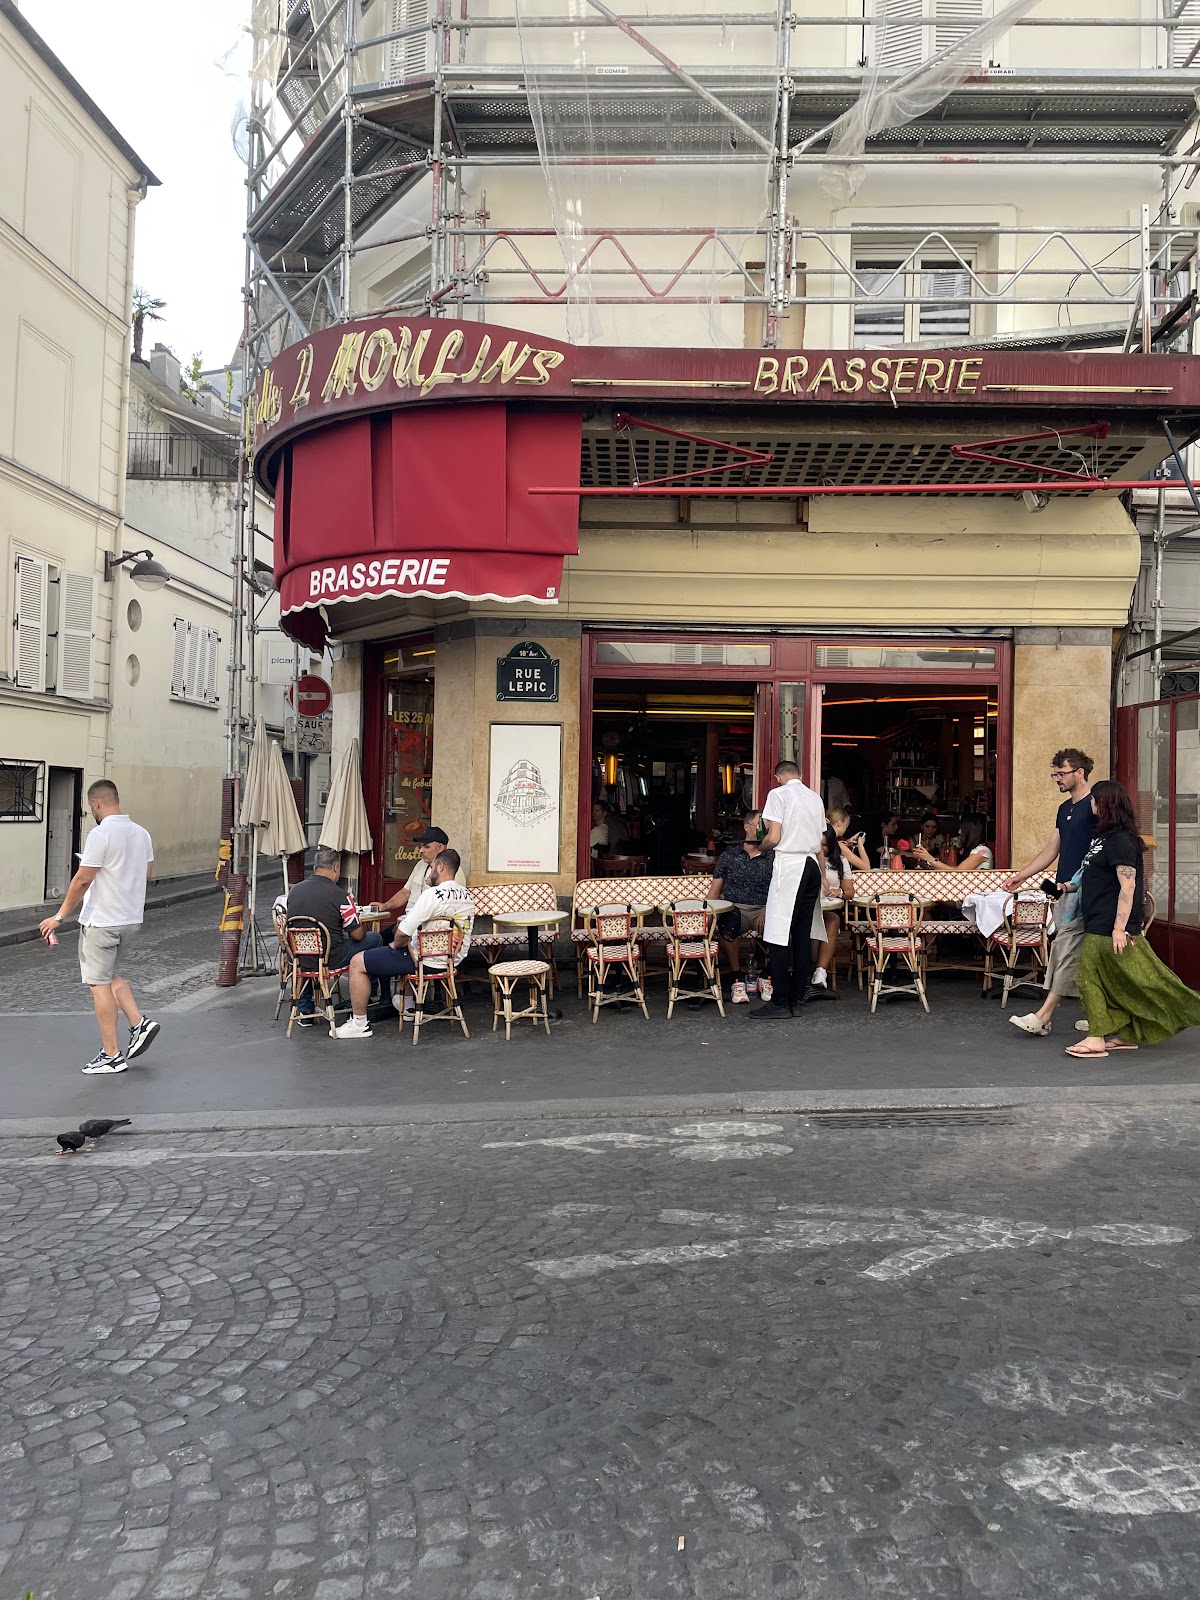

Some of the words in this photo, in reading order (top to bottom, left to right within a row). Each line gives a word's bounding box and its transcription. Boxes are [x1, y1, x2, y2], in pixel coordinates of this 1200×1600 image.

[289, 343, 314, 414] 2
[321, 326, 564, 403] MOULINS
[754, 356, 984, 395] BRASSERIE
[309, 558, 451, 596] BRASSERIE
[515, 668, 541, 679] RUE
[509, 681, 547, 692] LEPIC
[394, 710, 410, 723] LES
[411, 711, 424, 724] 25
[298, 720, 324, 729] SAUF
[401, 777, 411, 787] du
